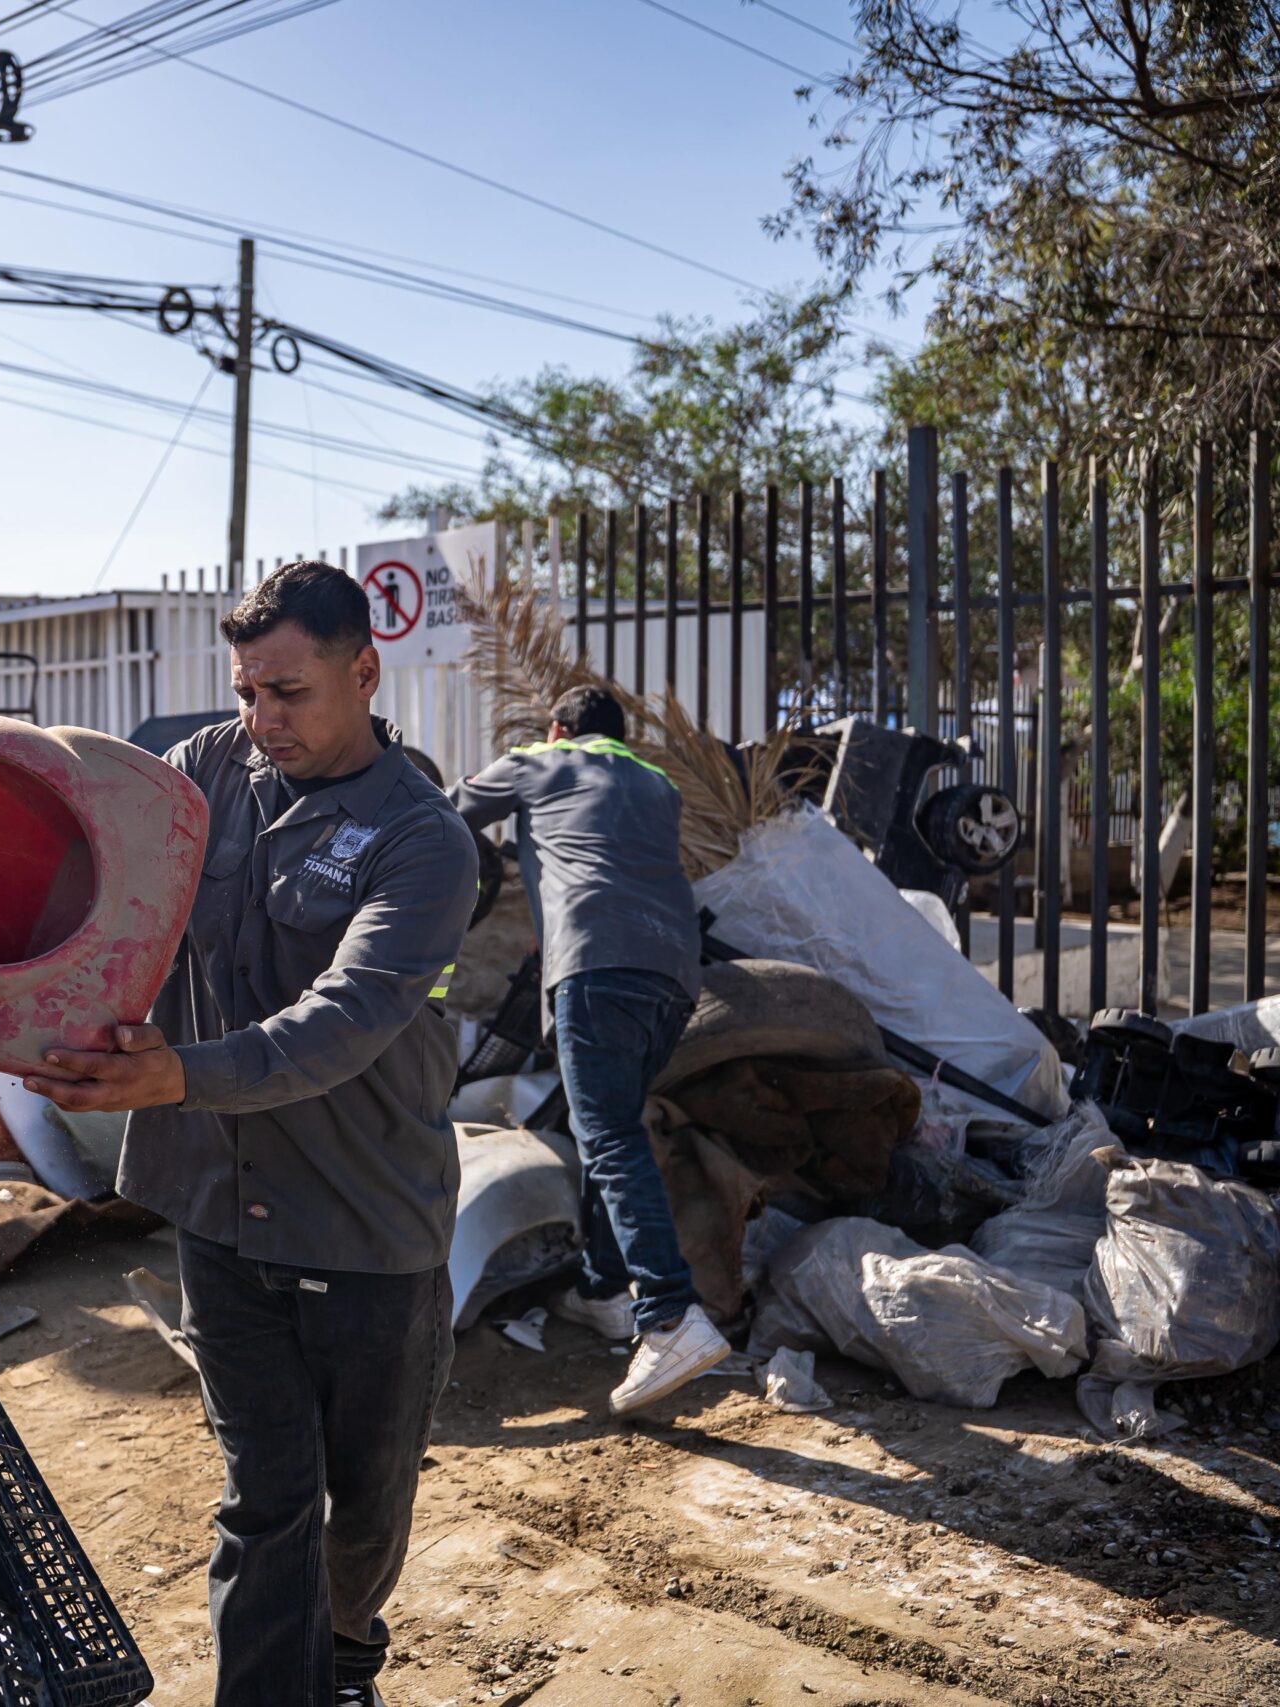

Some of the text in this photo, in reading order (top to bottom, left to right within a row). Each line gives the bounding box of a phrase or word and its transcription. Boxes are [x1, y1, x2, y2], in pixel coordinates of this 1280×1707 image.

[426, 566, 449, 586] NO
[426, 605, 470, 628] BASU
[303, 859, 352, 886] TIJUANA
